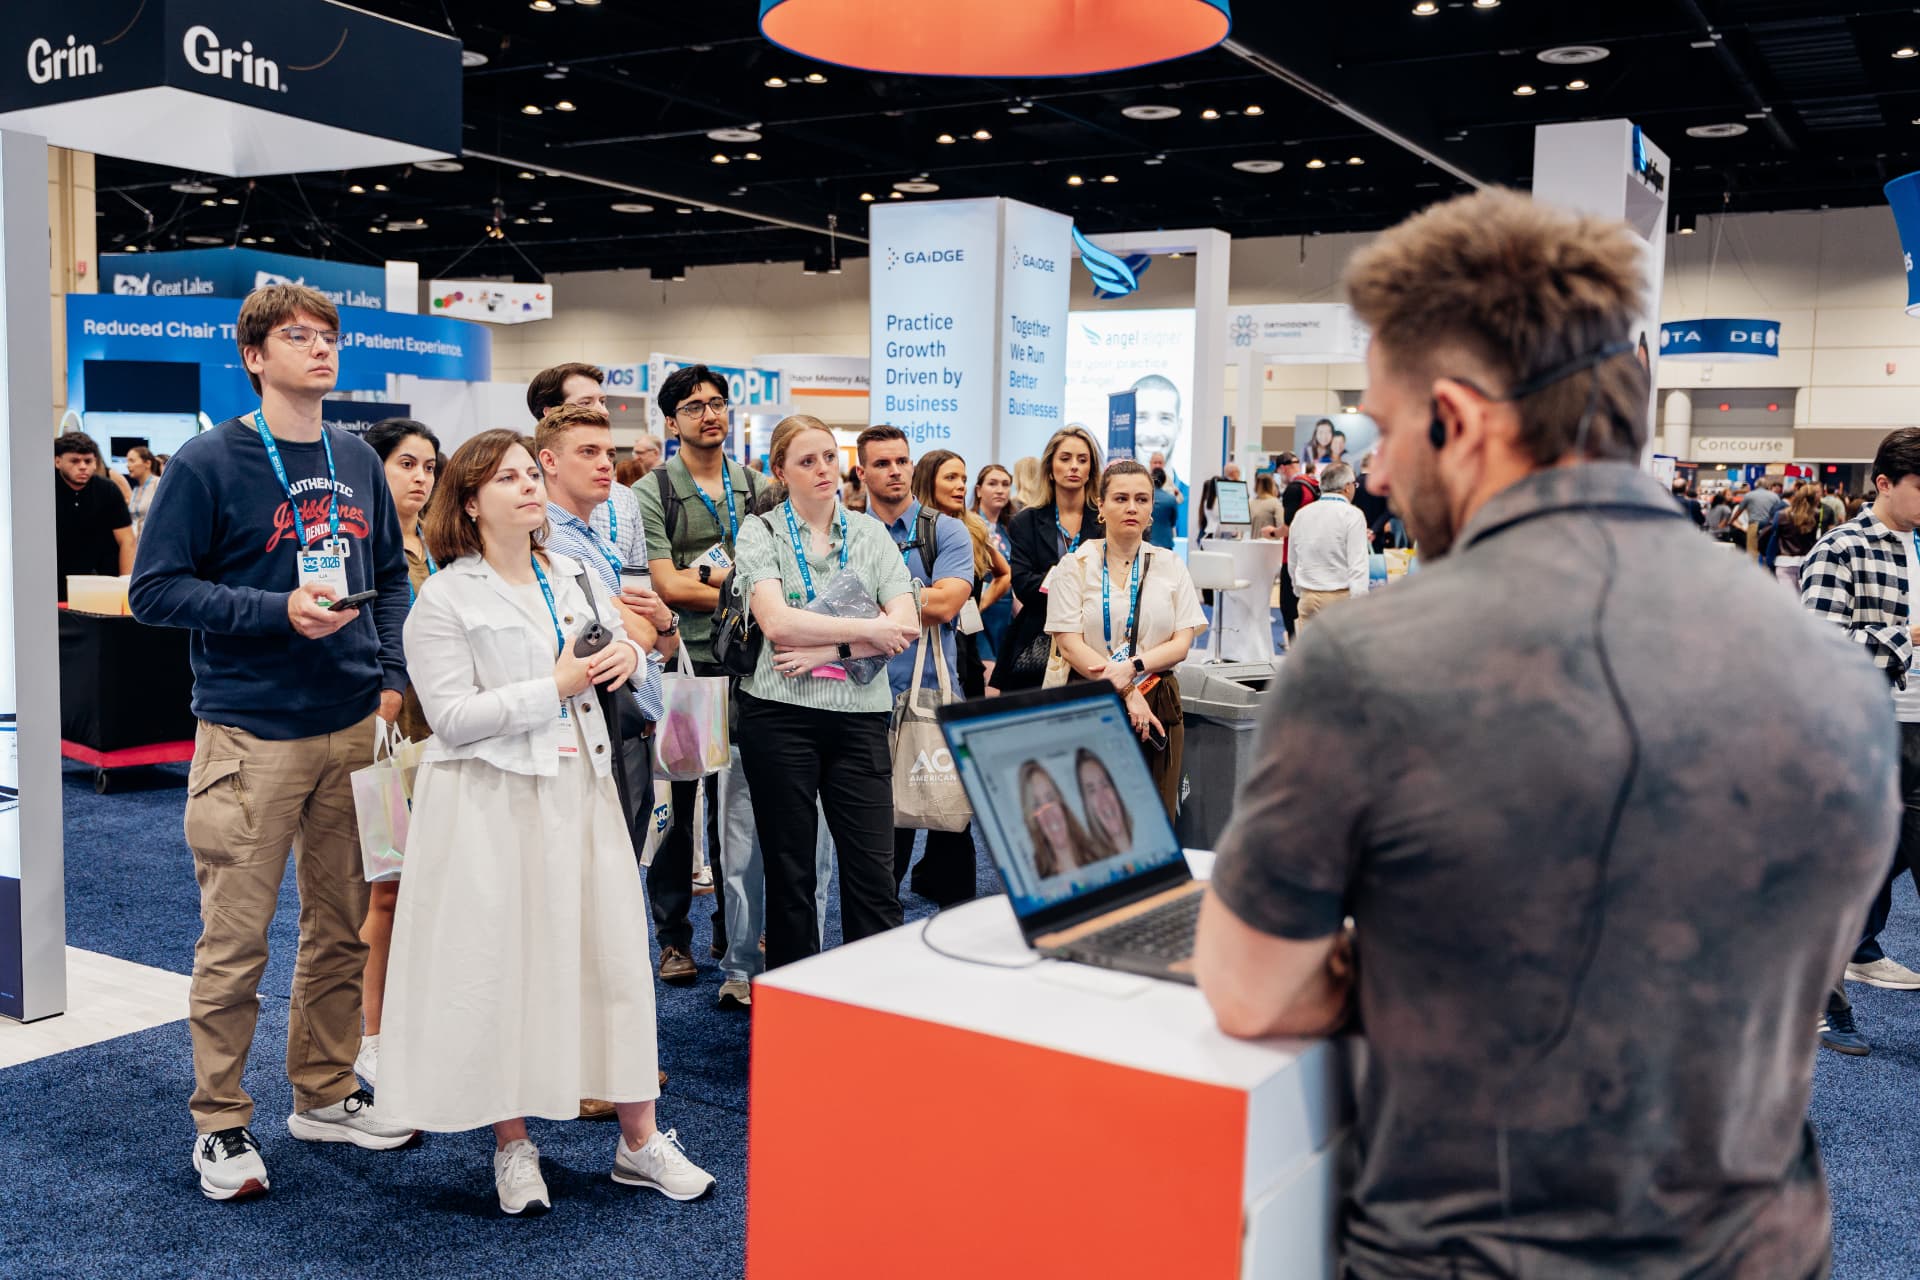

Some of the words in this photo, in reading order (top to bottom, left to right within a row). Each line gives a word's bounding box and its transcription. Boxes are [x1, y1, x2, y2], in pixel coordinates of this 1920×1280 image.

[152, 279, 182, 297] Great
[184, 276, 214, 296] Lakes
[346, 289, 382, 309] Lakes
[83, 319, 163, 337] Reduced
[166, 321, 217, 339] Chair
[887, 313, 953, 331] Practice
[1011, 315, 1051, 339] Together
[355, 332, 405, 351] Patient
[886, 340, 946, 358] Growth
[1105, 329, 1140, 350] angel
[1010, 343, 1025, 361] We
[1027, 345, 1045, 364] Run
[885, 367, 938, 385] Driven
[943, 367, 963, 388] by
[1009, 370, 1038, 390] Better
[885, 394, 958, 412] Business
[1008, 397, 1059, 419] Businesses
[1698, 438, 1784, 452] Concourse
[288, 477, 353, 498] AUTHENTIC
[320, 556, 341, 568] 2026
[910, 774, 957, 782] AMERICAN
